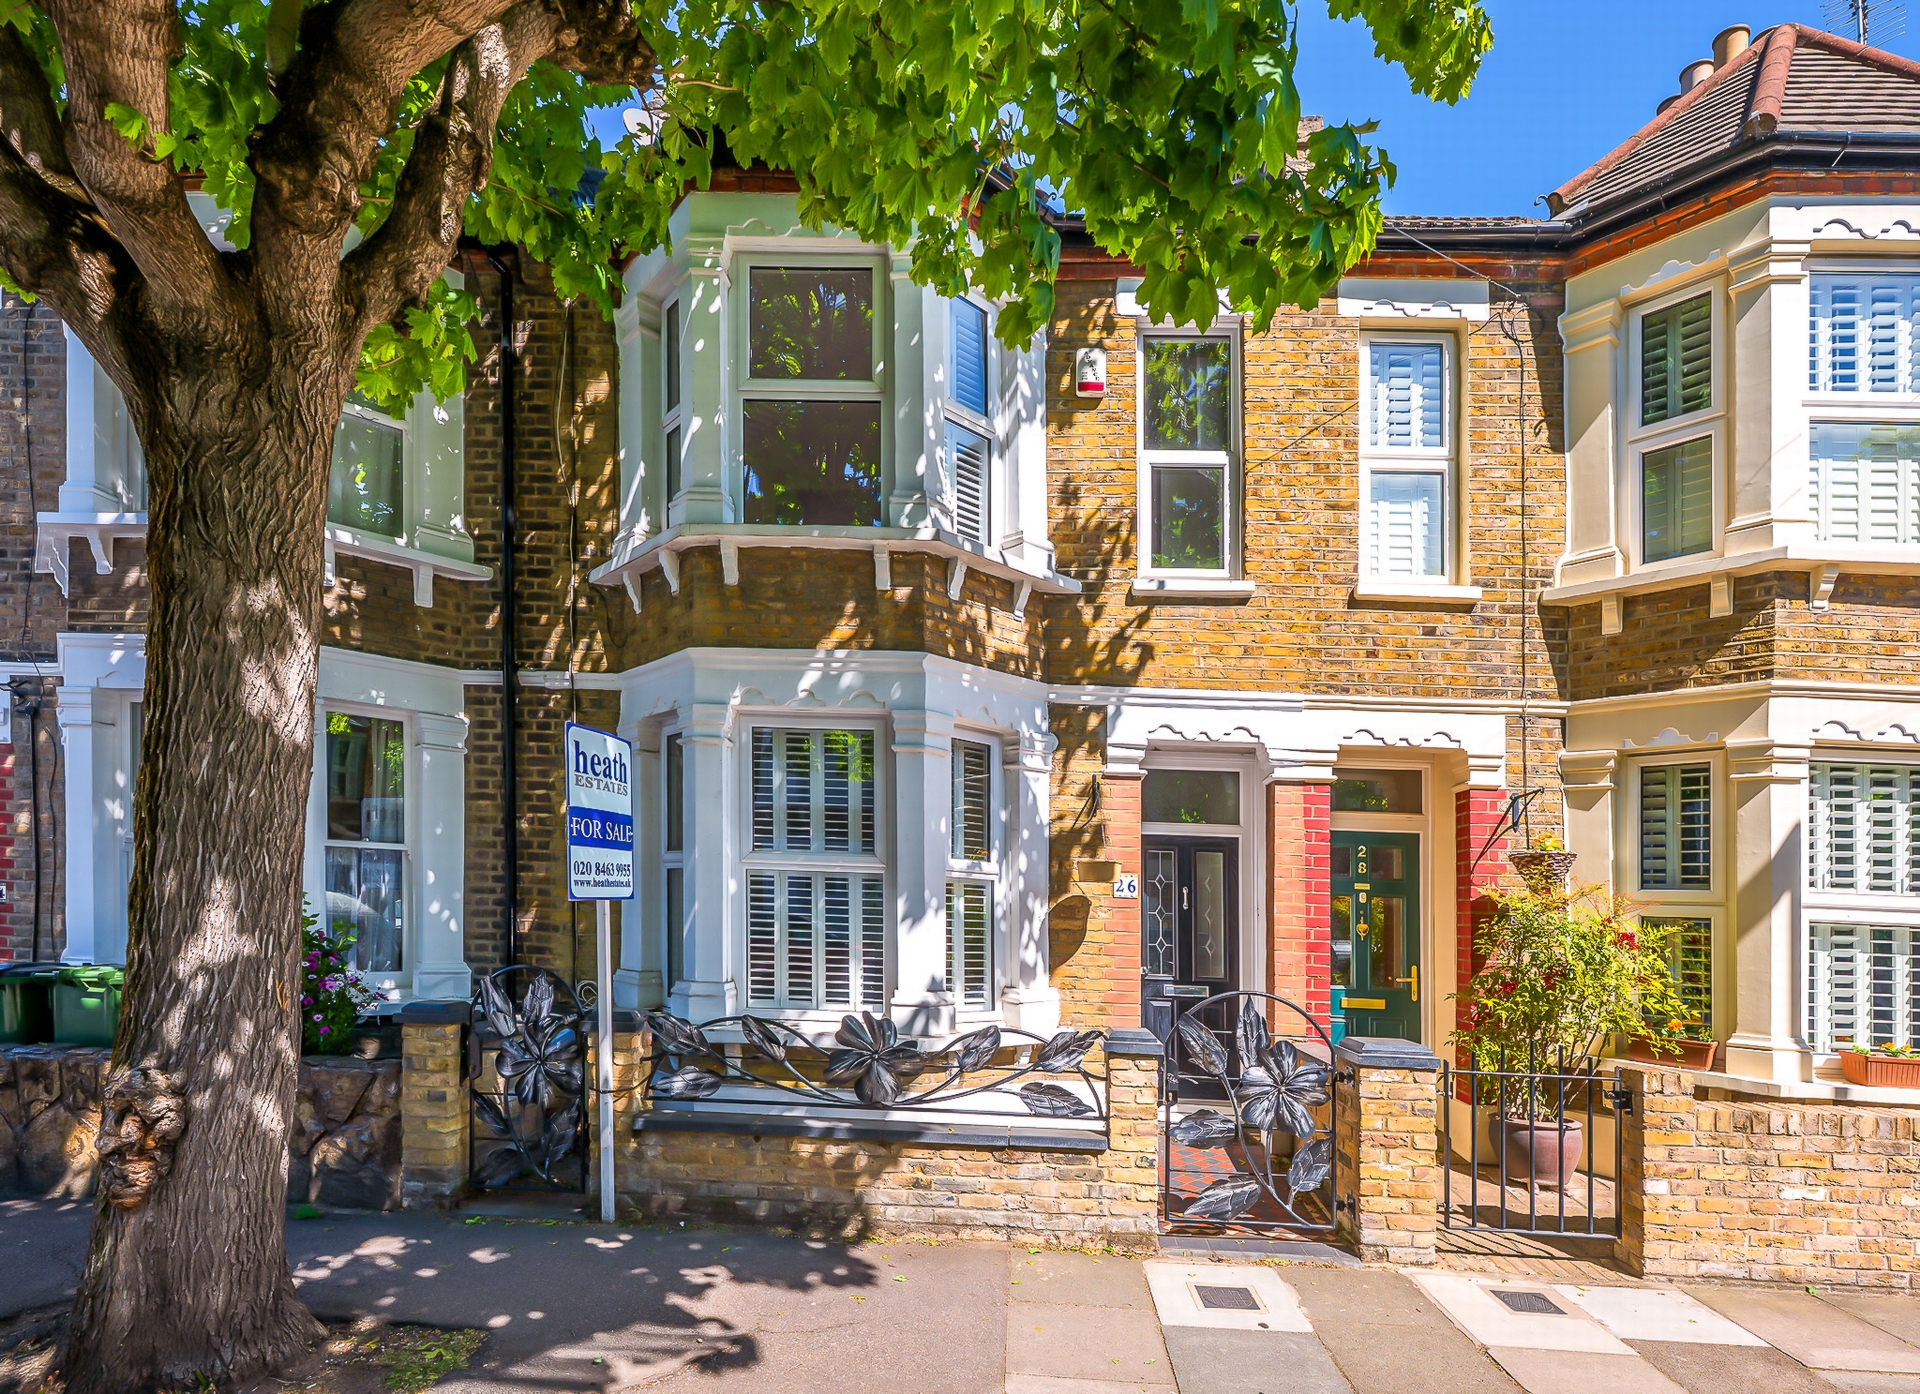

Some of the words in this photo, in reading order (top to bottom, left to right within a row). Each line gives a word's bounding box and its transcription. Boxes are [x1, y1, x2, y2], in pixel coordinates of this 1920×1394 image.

[573, 739, 628, 784] heath
[574, 774, 628, 797] ESTATES
[571, 816, 603, 839] FOR
[605, 821, 632, 843] SALE
[573, 860, 592, 876] 020
[594, 861, 615, 877] 8463
[615, 862, 631, 878] 9955
[1115, 879, 1136, 893] 26
